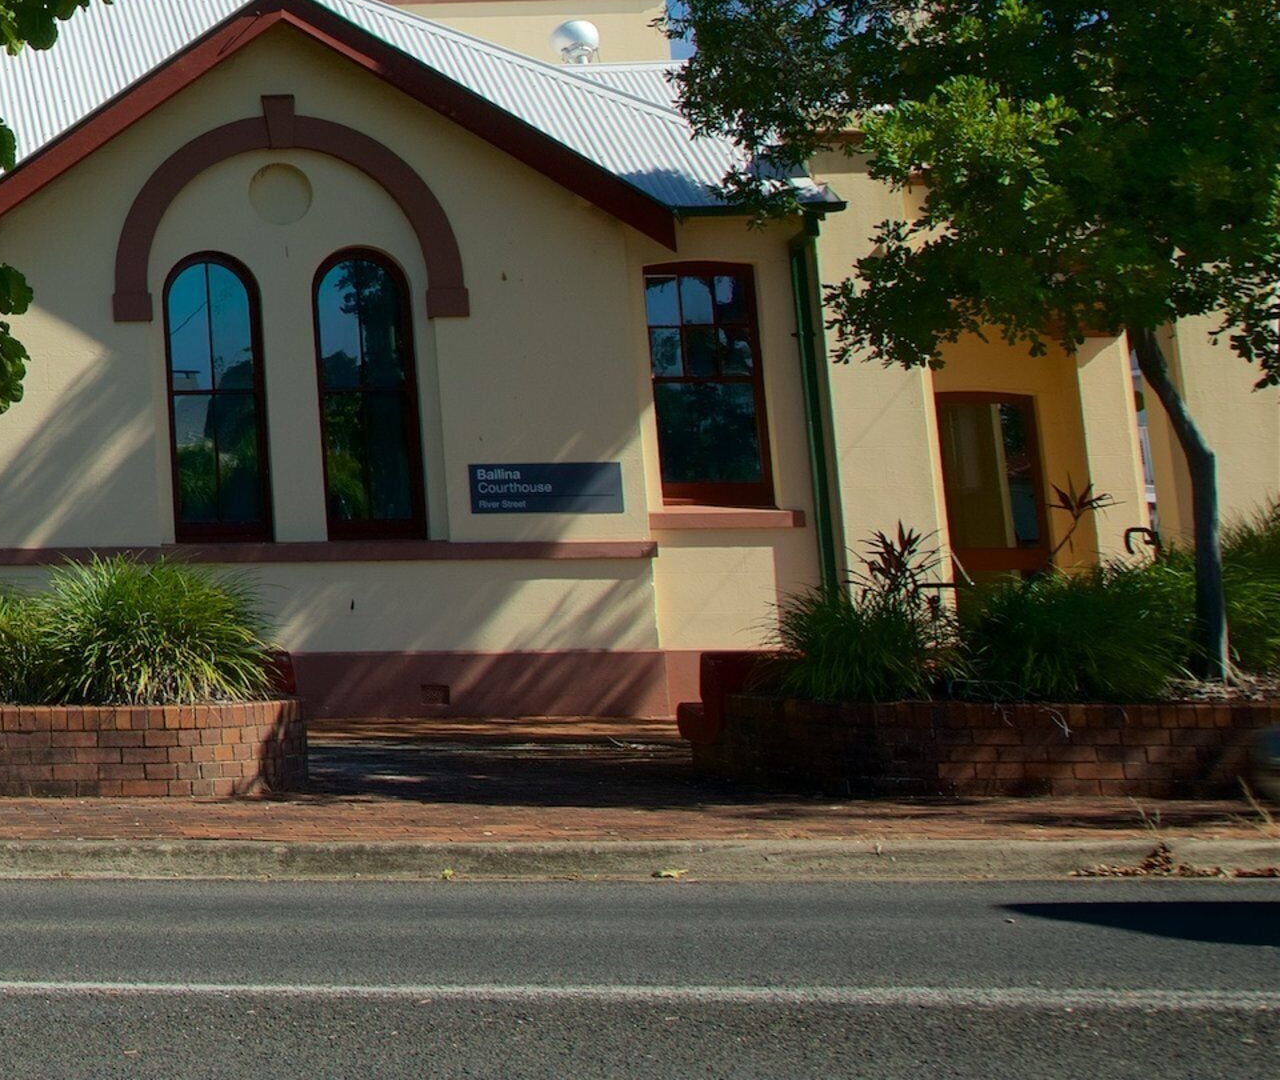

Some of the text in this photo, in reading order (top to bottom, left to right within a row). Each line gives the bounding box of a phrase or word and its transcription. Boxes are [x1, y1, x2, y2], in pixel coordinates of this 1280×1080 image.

[476, 468, 521, 480] Ballina
[478, 481, 552, 494] Courthouse
[478, 499, 527, 509] River Street
